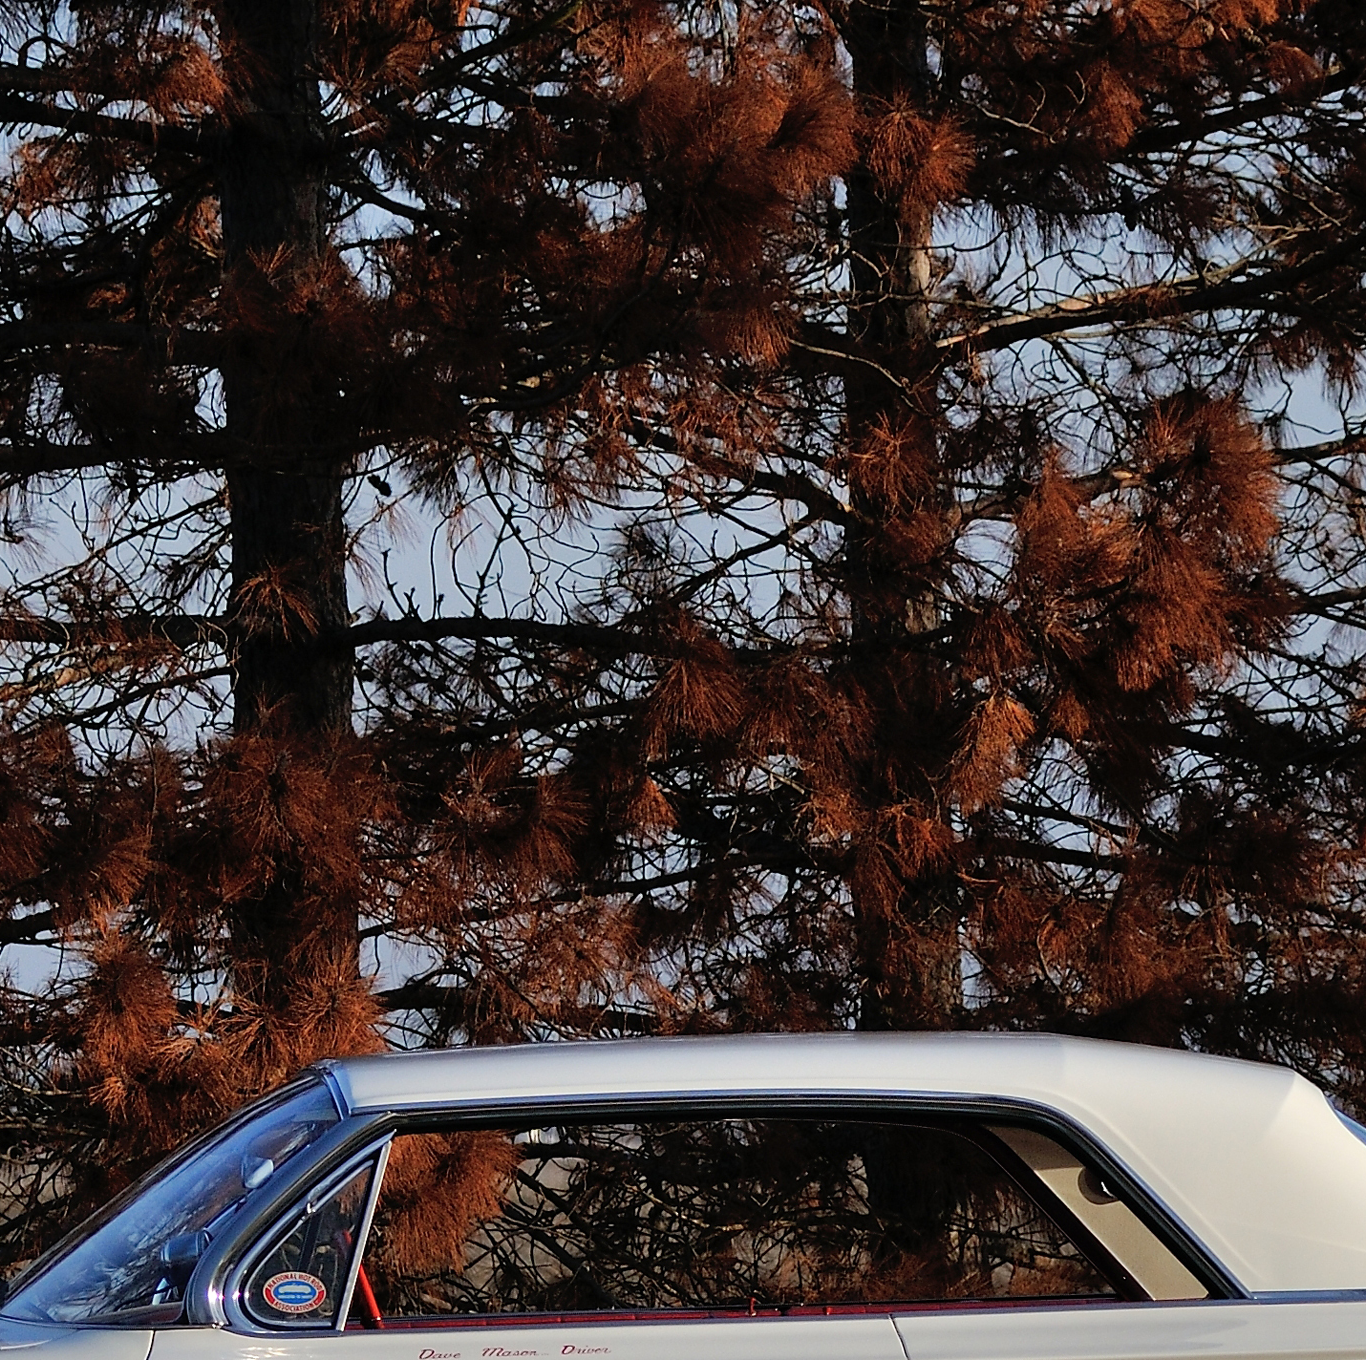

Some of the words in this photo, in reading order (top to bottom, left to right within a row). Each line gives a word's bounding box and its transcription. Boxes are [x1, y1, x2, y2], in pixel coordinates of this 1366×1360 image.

[273, 1301, 315, 1312] ASSOCIATION
[418, 1347, 462, 1360] Dave
[560, 1344, 612, 1355] Driver
